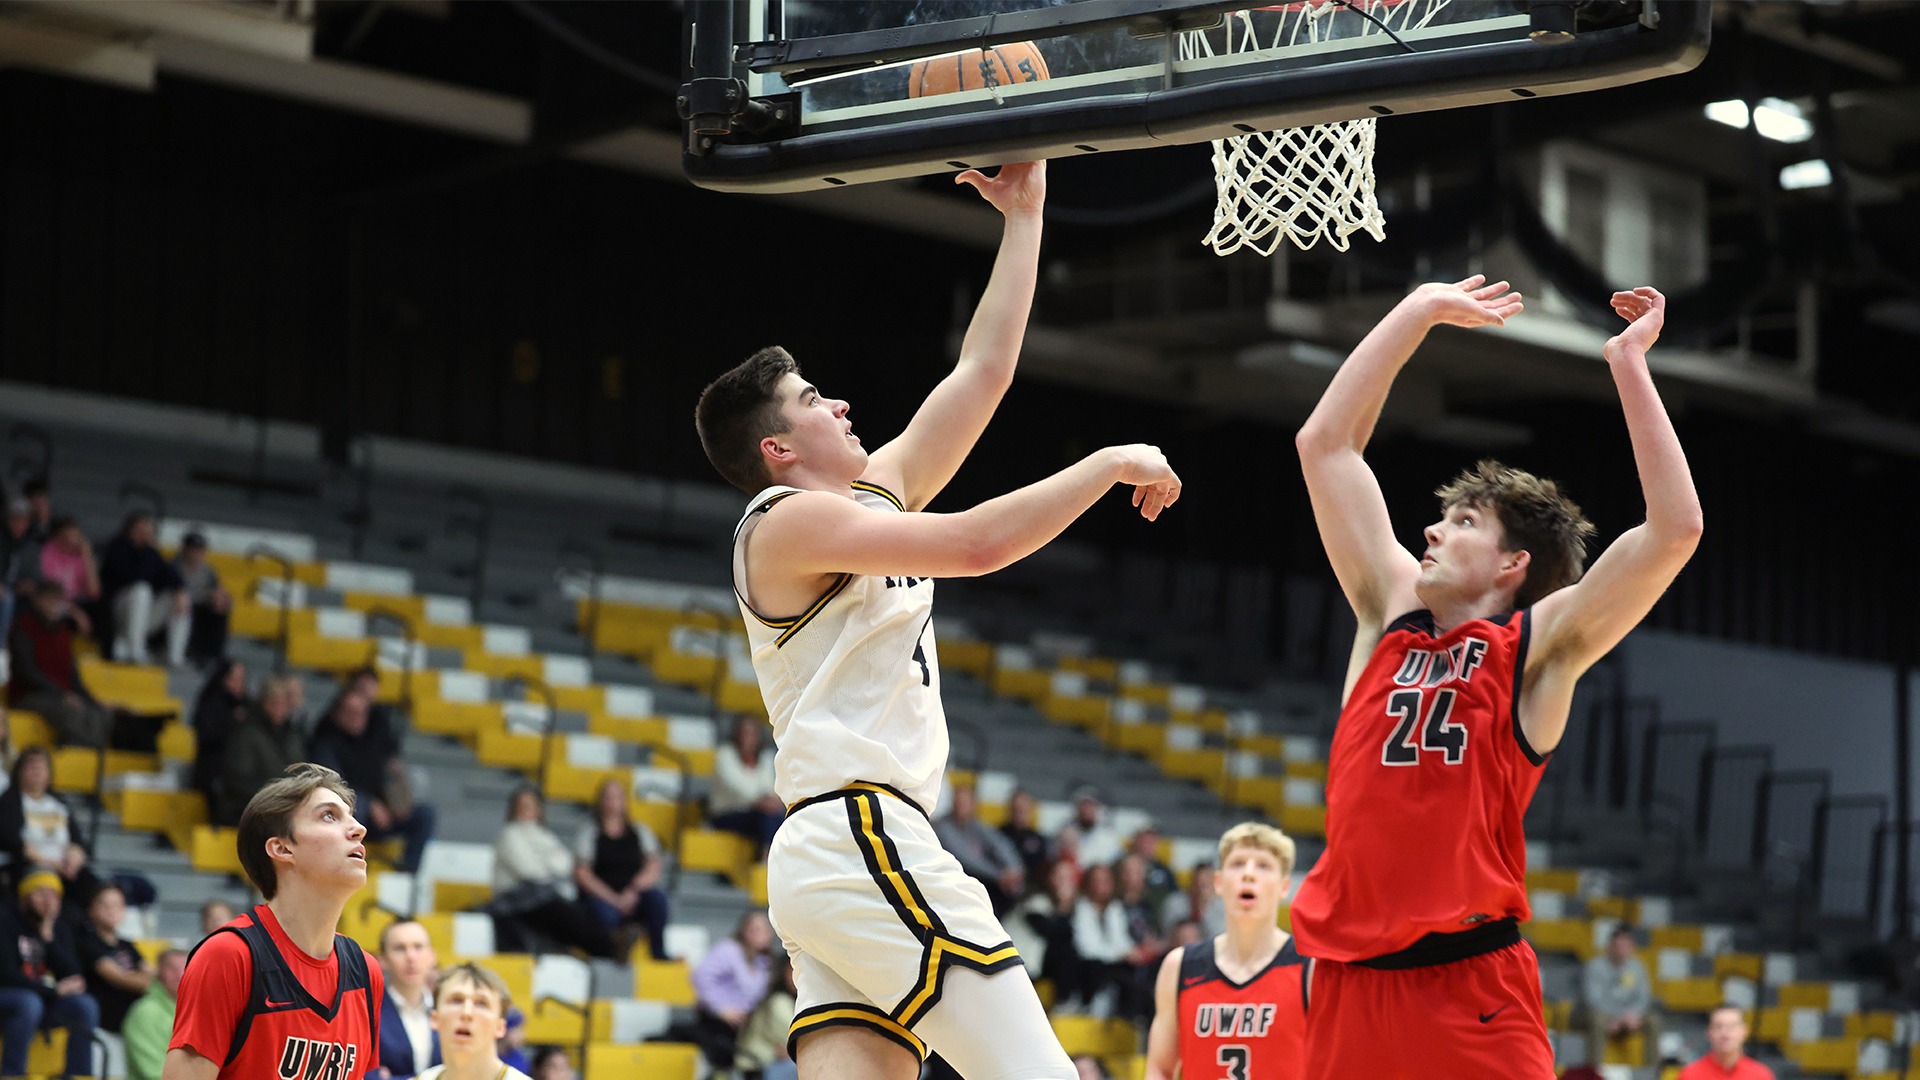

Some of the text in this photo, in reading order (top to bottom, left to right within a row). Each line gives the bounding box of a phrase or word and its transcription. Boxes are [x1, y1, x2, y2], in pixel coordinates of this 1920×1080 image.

[1381, 688, 1468, 766] 24
[1194, 1003, 1277, 1038] UWRF
[278, 1036, 357, 1080] UWRF
[1216, 1044, 1252, 1080] 3
